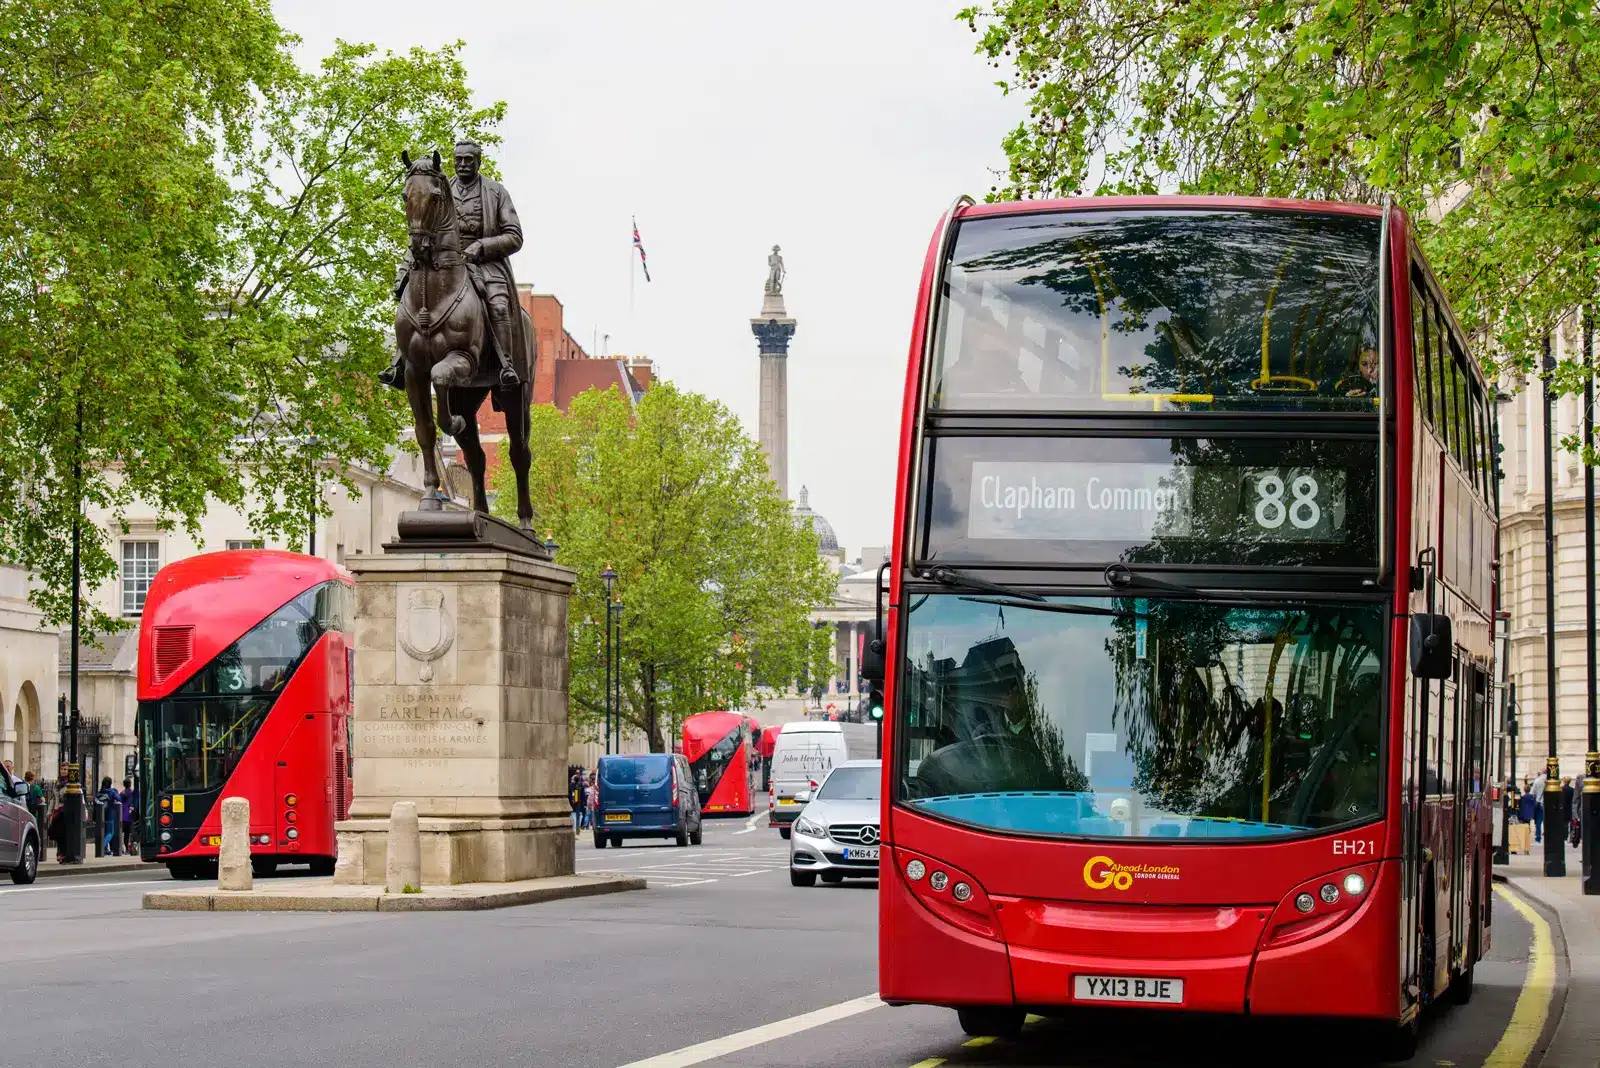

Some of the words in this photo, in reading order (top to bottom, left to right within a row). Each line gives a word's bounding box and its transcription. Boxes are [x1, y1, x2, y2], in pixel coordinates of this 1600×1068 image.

[980, 476, 1075, 518] Clapham
[1086, 476, 1178, 510] Common
[1254, 475, 1321, 529] 88
[227, 667, 243, 690] 3
[385, 694, 414, 703] FIELD
[380, 707, 422, 719] EARL
[429, 706, 473, 719] HAIG
[364, 736, 376, 744] OF
[380, 736, 400, 744] THE
[449, 736, 488, 744] ARMIES
[412, 748, 456, 756] FRANCE
[782, 754, 798, 764] John
[849, 849, 871, 858] KM64
[1333, 840, 1375, 855] EH21
[1083, 856, 1133, 891] Go
[1111, 864, 1180, 873] Ahead-London
[1087, 978, 1129, 997] YX13
[1134, 978, 1171, 998] BJE
